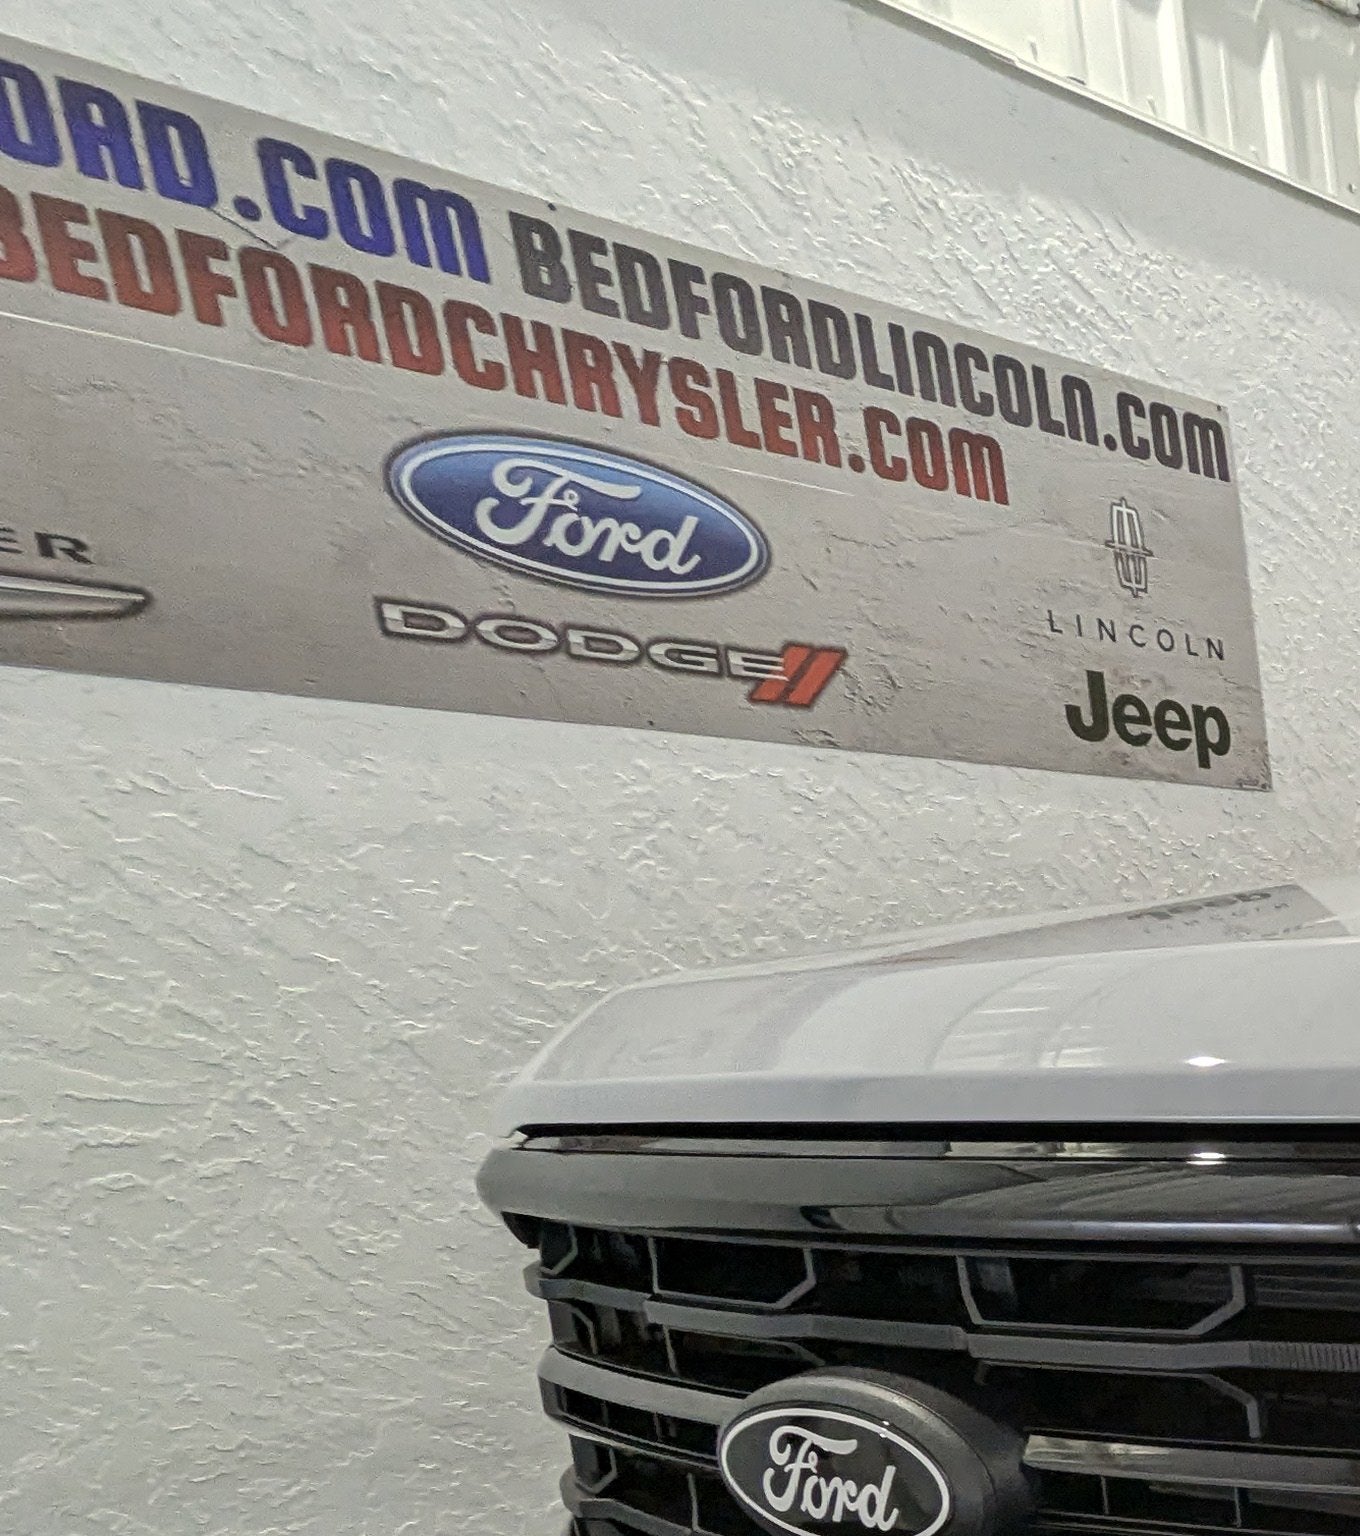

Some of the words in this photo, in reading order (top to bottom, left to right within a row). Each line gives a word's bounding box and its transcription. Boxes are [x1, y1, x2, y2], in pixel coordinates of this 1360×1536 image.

[0, 58, 490, 284] ORD.COM
[508, 211, 1231, 483] BEDFORDLINCOLN.COM
[475, 458, 701, 575] Ford
[376, 599, 792, 683] DODGE
[1048, 609, 1224, 661] LINCOLN
[1064, 669, 1231, 769] Jeep
[763, 1425, 899, 1532] Ford
